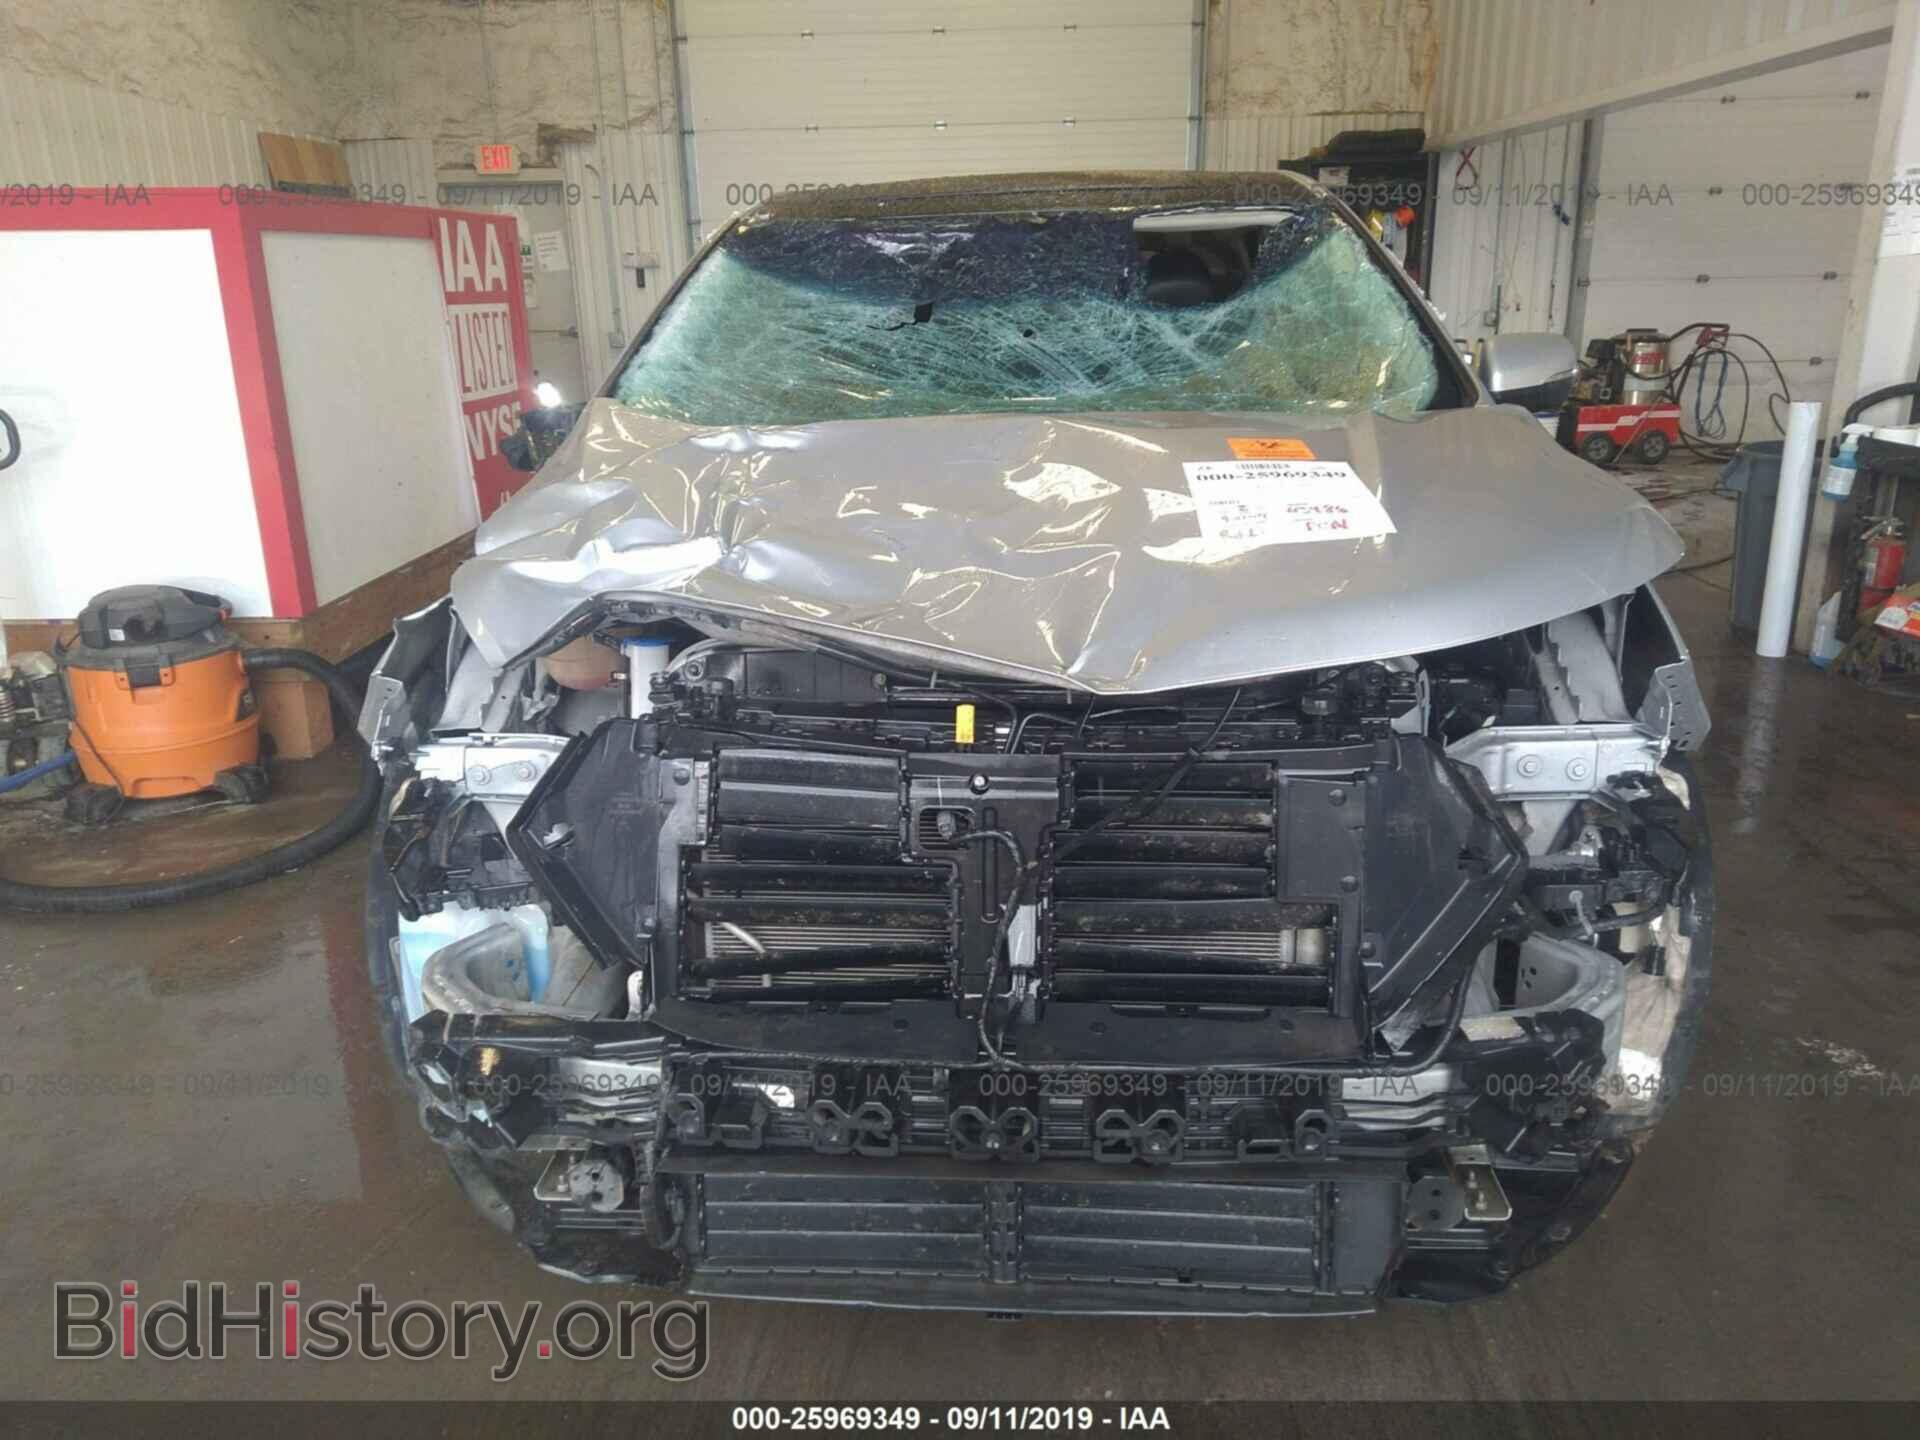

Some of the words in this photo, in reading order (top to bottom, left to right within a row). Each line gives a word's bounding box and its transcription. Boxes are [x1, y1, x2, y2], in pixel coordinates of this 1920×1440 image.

[481, 145, 513, 169] EXIT
[439, 217, 508, 292] IAA
[455, 311, 514, 393] LISTED
[1196, 470, 1347, 482] 000-25969349
